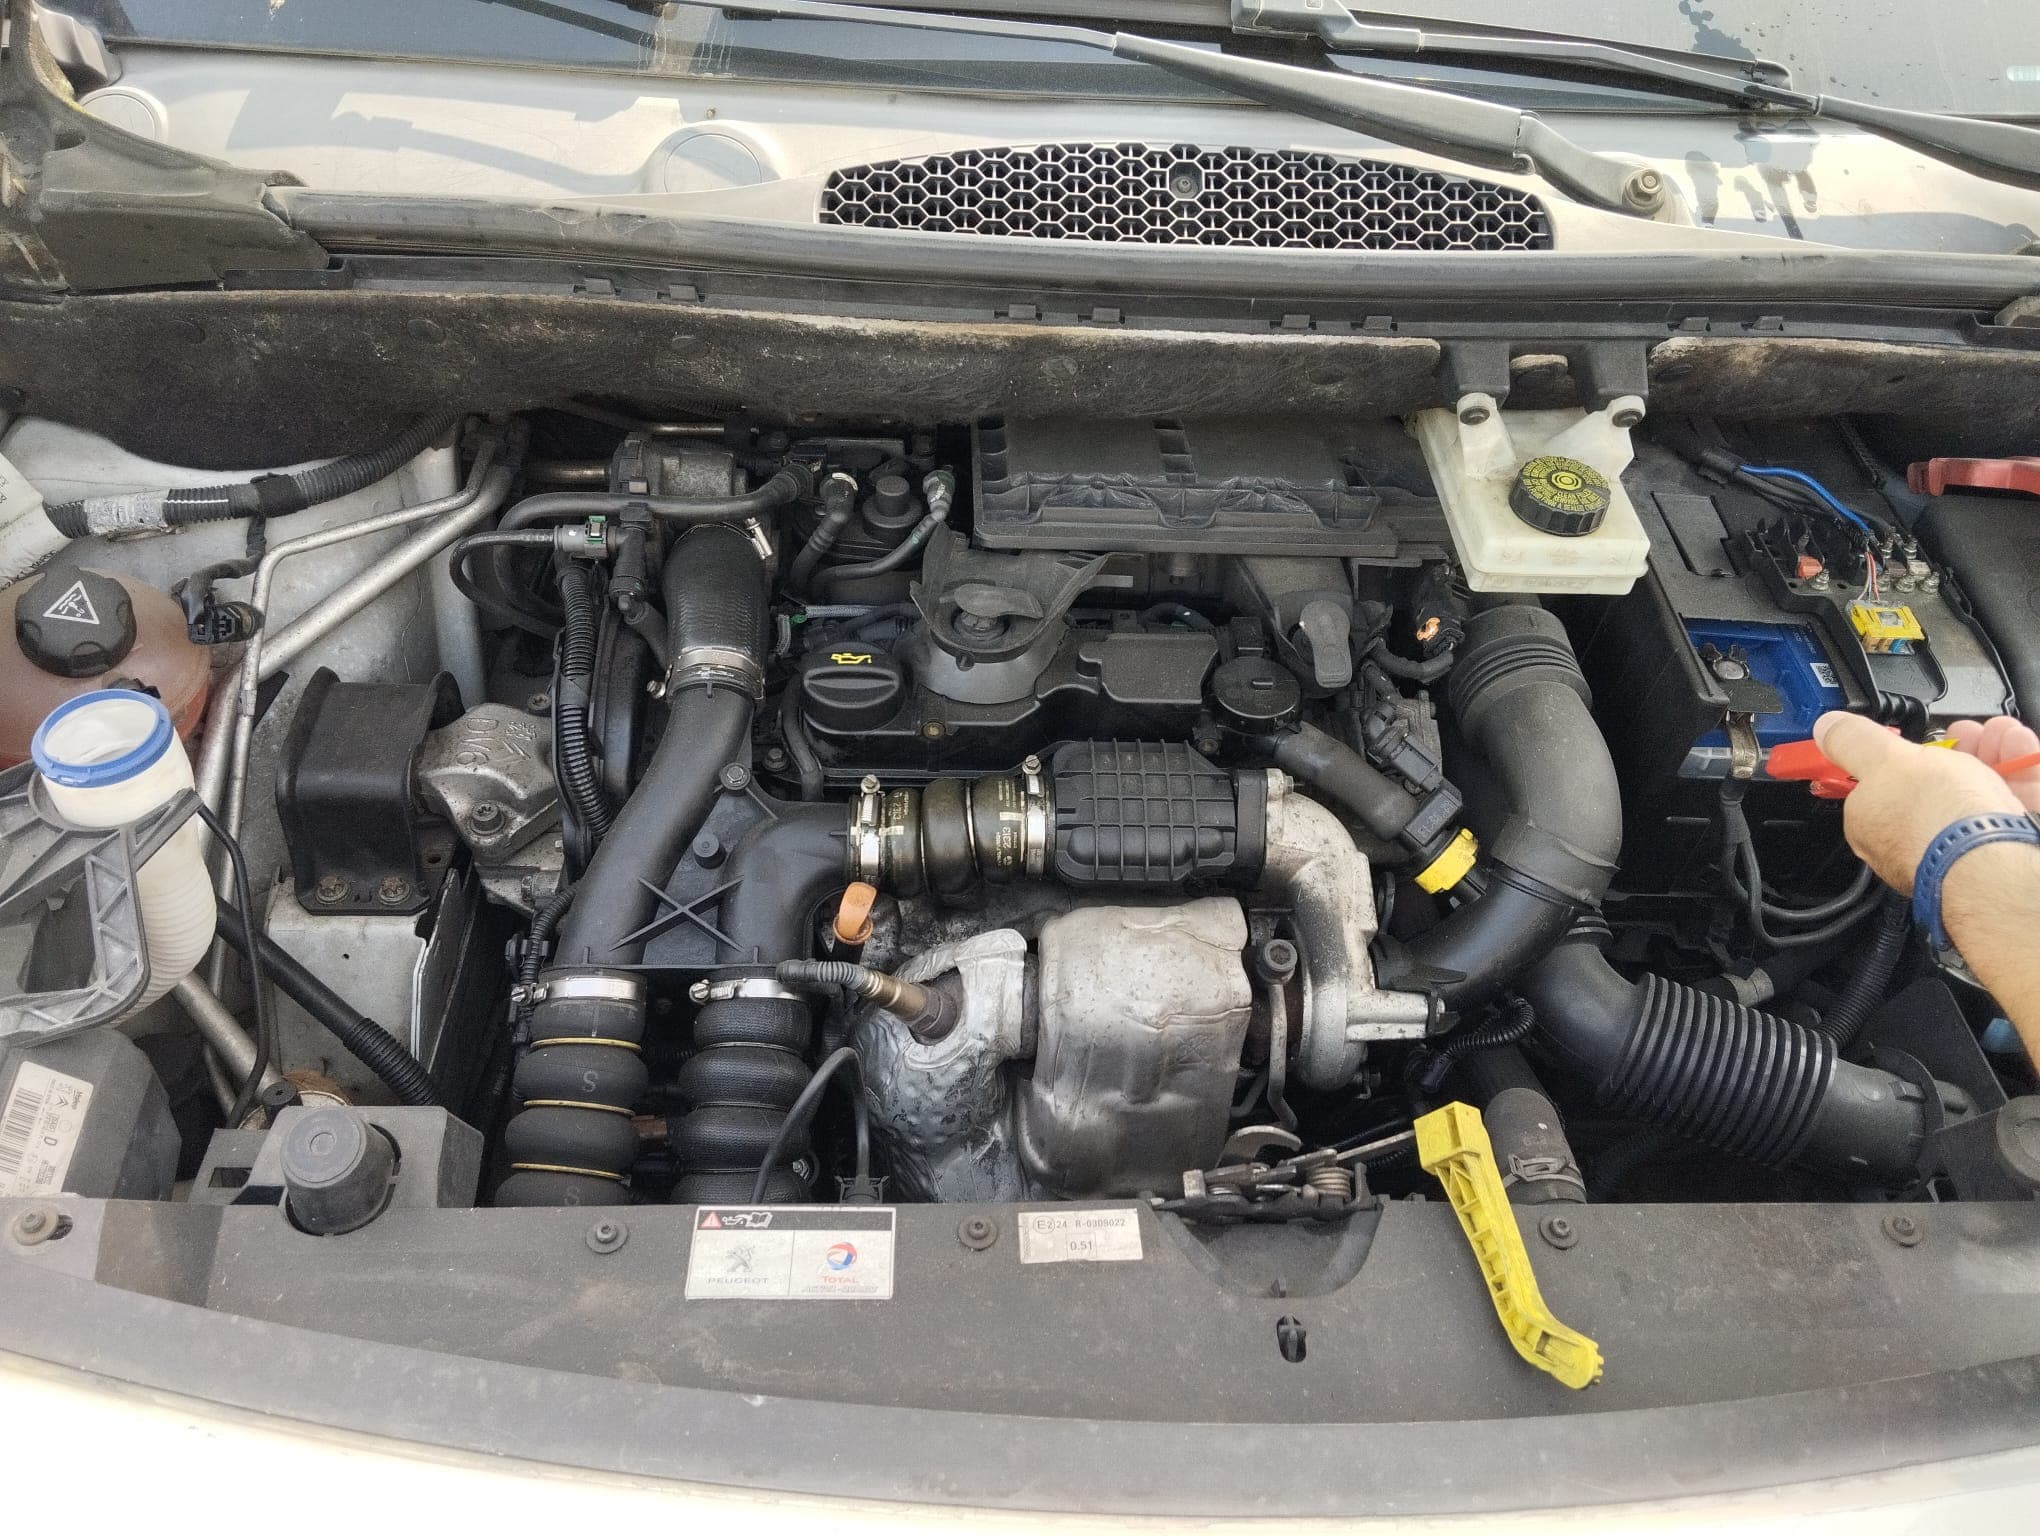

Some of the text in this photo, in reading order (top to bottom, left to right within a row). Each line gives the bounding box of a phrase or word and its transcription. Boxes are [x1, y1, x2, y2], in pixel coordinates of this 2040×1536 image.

[1002, 826, 1012, 849] 2313
[582, 1069, 598, 1093] S
[1056, 1219, 1067, 1229] 24
[1070, 1240, 1093, 1252] 0.51
[706, 1276, 769, 1285] PEUGEOT
[821, 1275, 859, 1285] TOTAL
